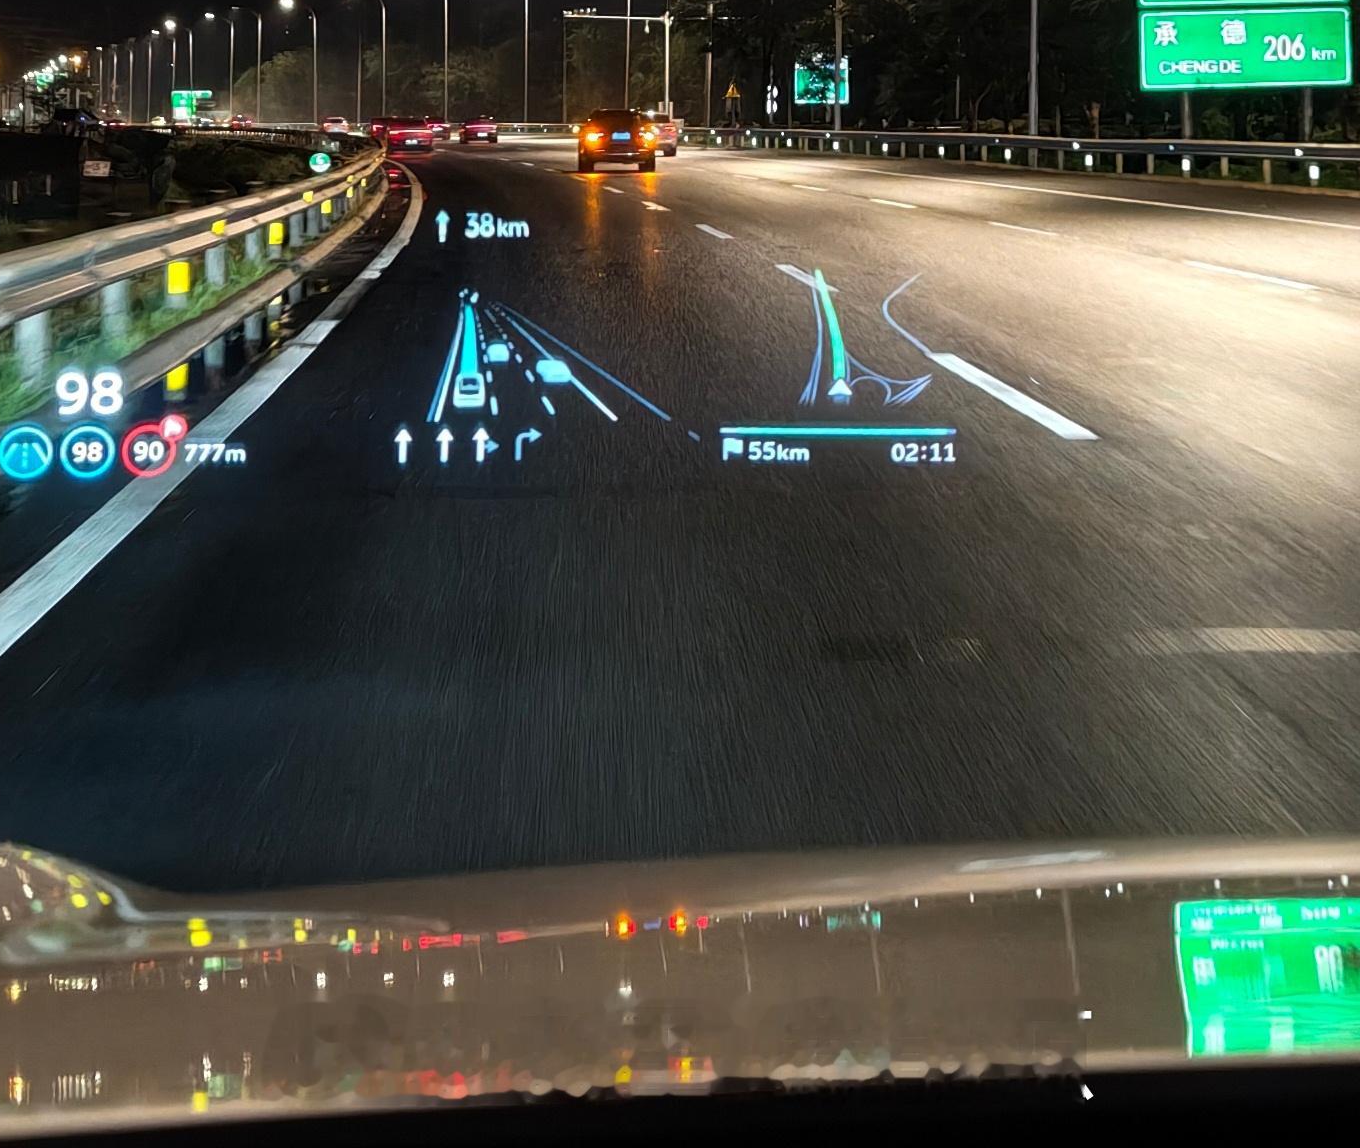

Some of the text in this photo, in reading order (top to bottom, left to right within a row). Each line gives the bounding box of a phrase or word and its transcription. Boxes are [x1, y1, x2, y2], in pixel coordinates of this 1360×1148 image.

[1153, 19, 1246, 46] 承德
[1263, 34, 1337, 61] 206 km
[55, 371, 124, 416] 98
[71, 442, 104, 463] 98
[133, 440, 165, 463] 90
[183, 442, 247, 464] 777m
[748, 440, 810, 461] 55km
[890, 442, 956, 463] 02:11
